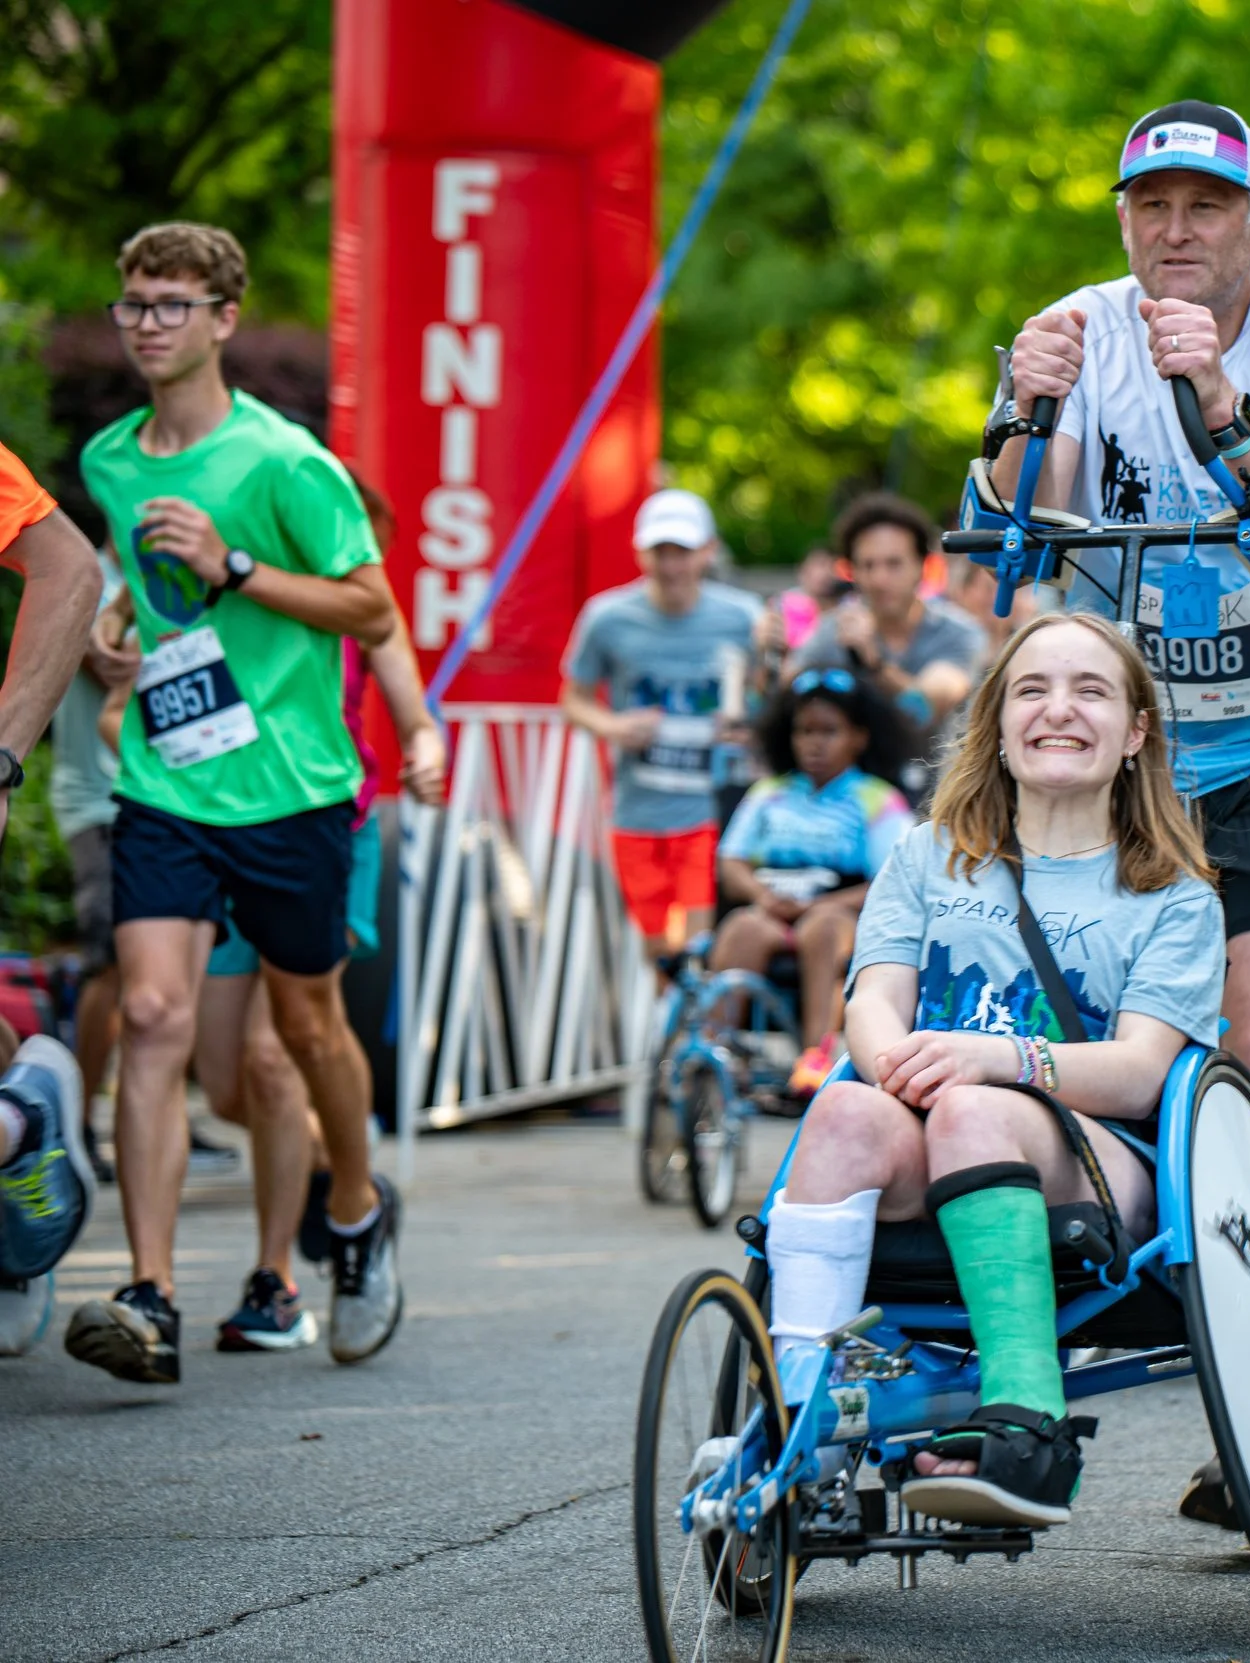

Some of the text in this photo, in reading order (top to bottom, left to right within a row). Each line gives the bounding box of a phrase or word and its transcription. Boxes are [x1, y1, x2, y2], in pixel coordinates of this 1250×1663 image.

[413, 158, 503, 652] FINISH
[1143, 632, 1244, 677] 9908
[148, 669, 216, 728] 9957
